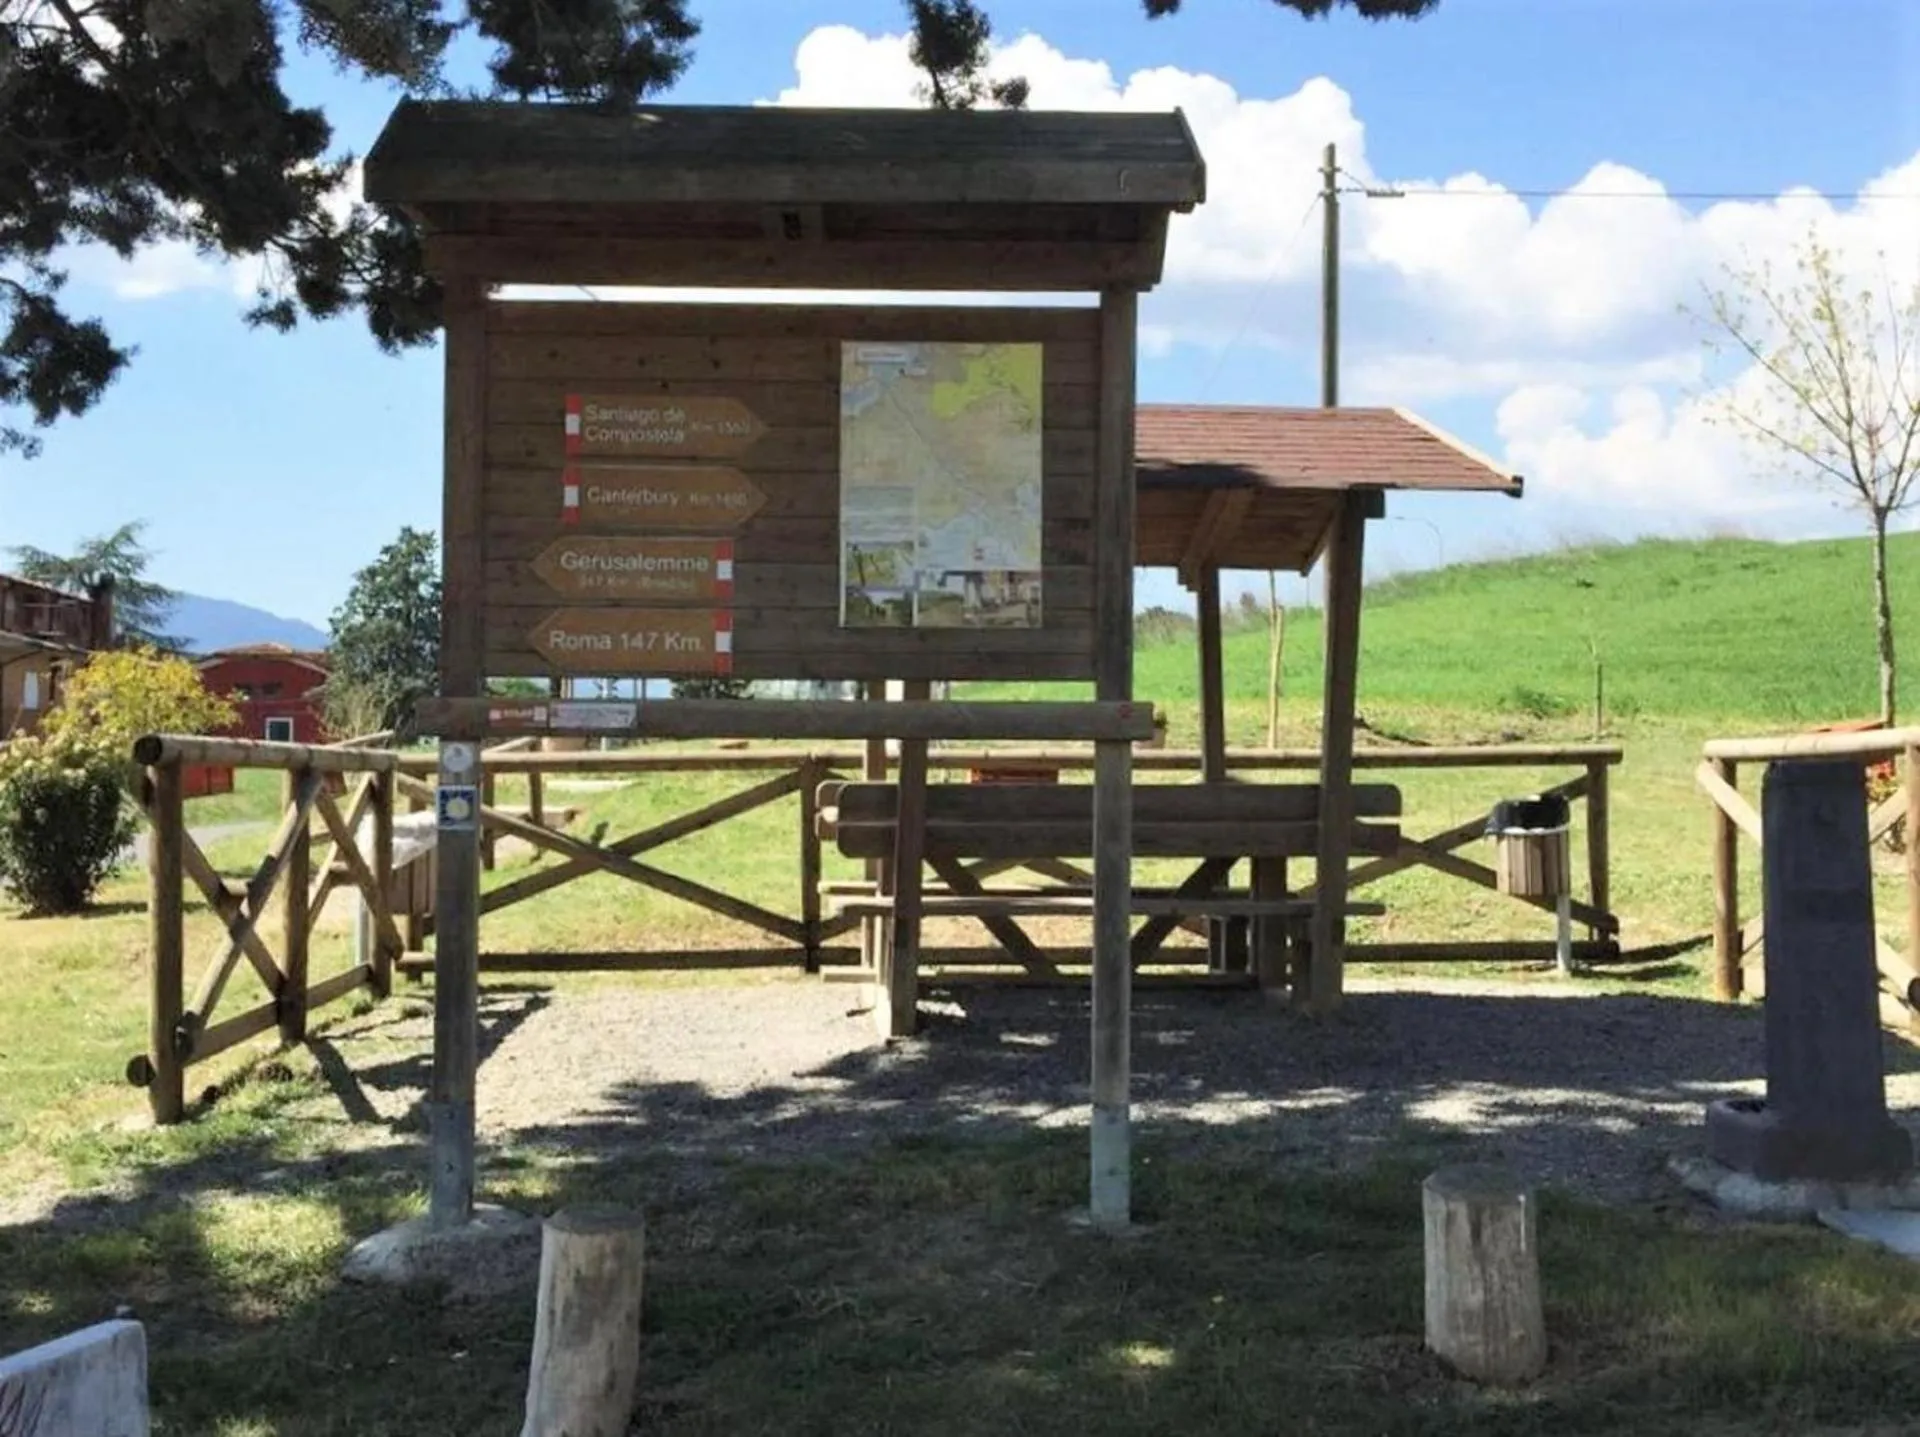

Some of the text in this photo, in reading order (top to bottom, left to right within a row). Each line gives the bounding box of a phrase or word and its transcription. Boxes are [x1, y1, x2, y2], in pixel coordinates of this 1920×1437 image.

[584, 403, 686, 426] Santiago de
[584, 425, 685, 444] Compostela
[587, 485, 679, 507] Canterbury
[560, 550, 709, 573] Gerusalemme
[549, 630, 612, 650] Roma
[620, 630, 659, 650] 147
